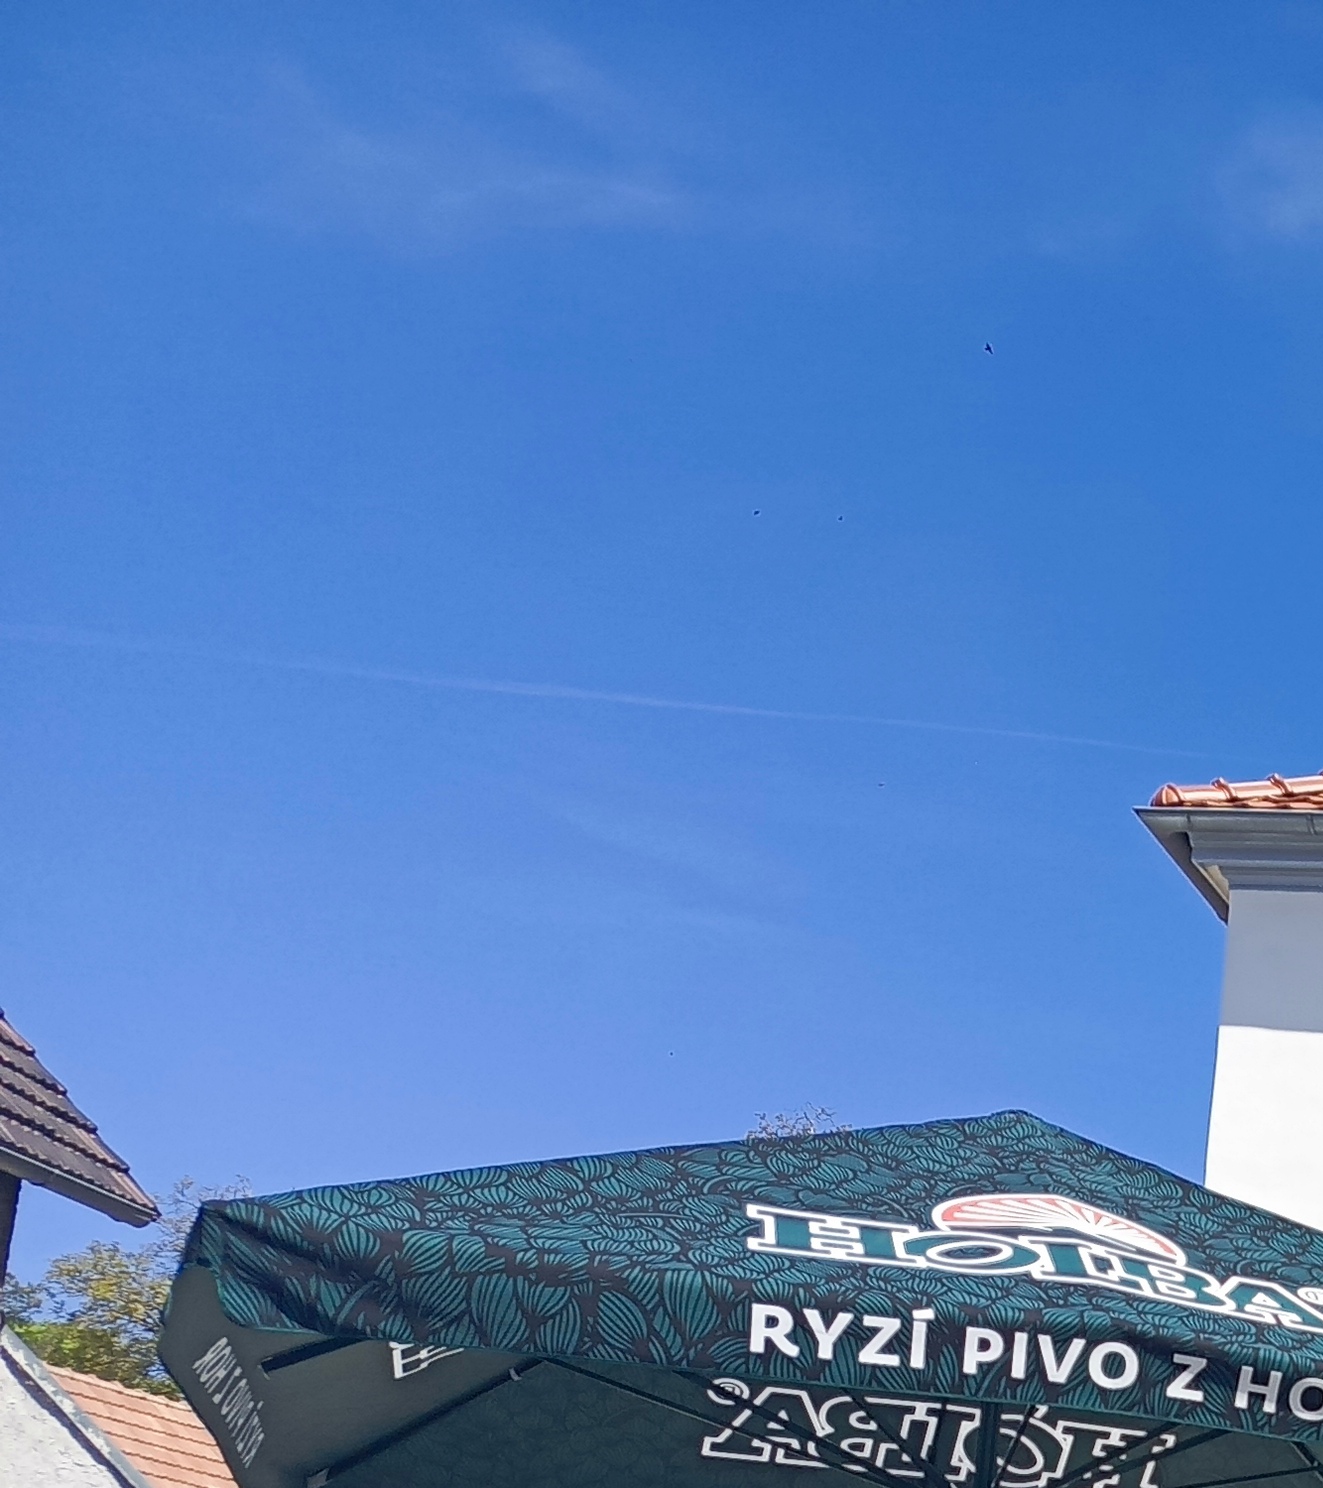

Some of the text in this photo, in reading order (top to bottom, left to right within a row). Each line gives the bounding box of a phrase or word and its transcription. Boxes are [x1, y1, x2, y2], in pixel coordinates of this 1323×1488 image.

[749, 1302, 934, 1369] RYZÍ
[962, 1325, 1140, 1390] PIVO
[1169, 1352, 1208, 1404] Z
